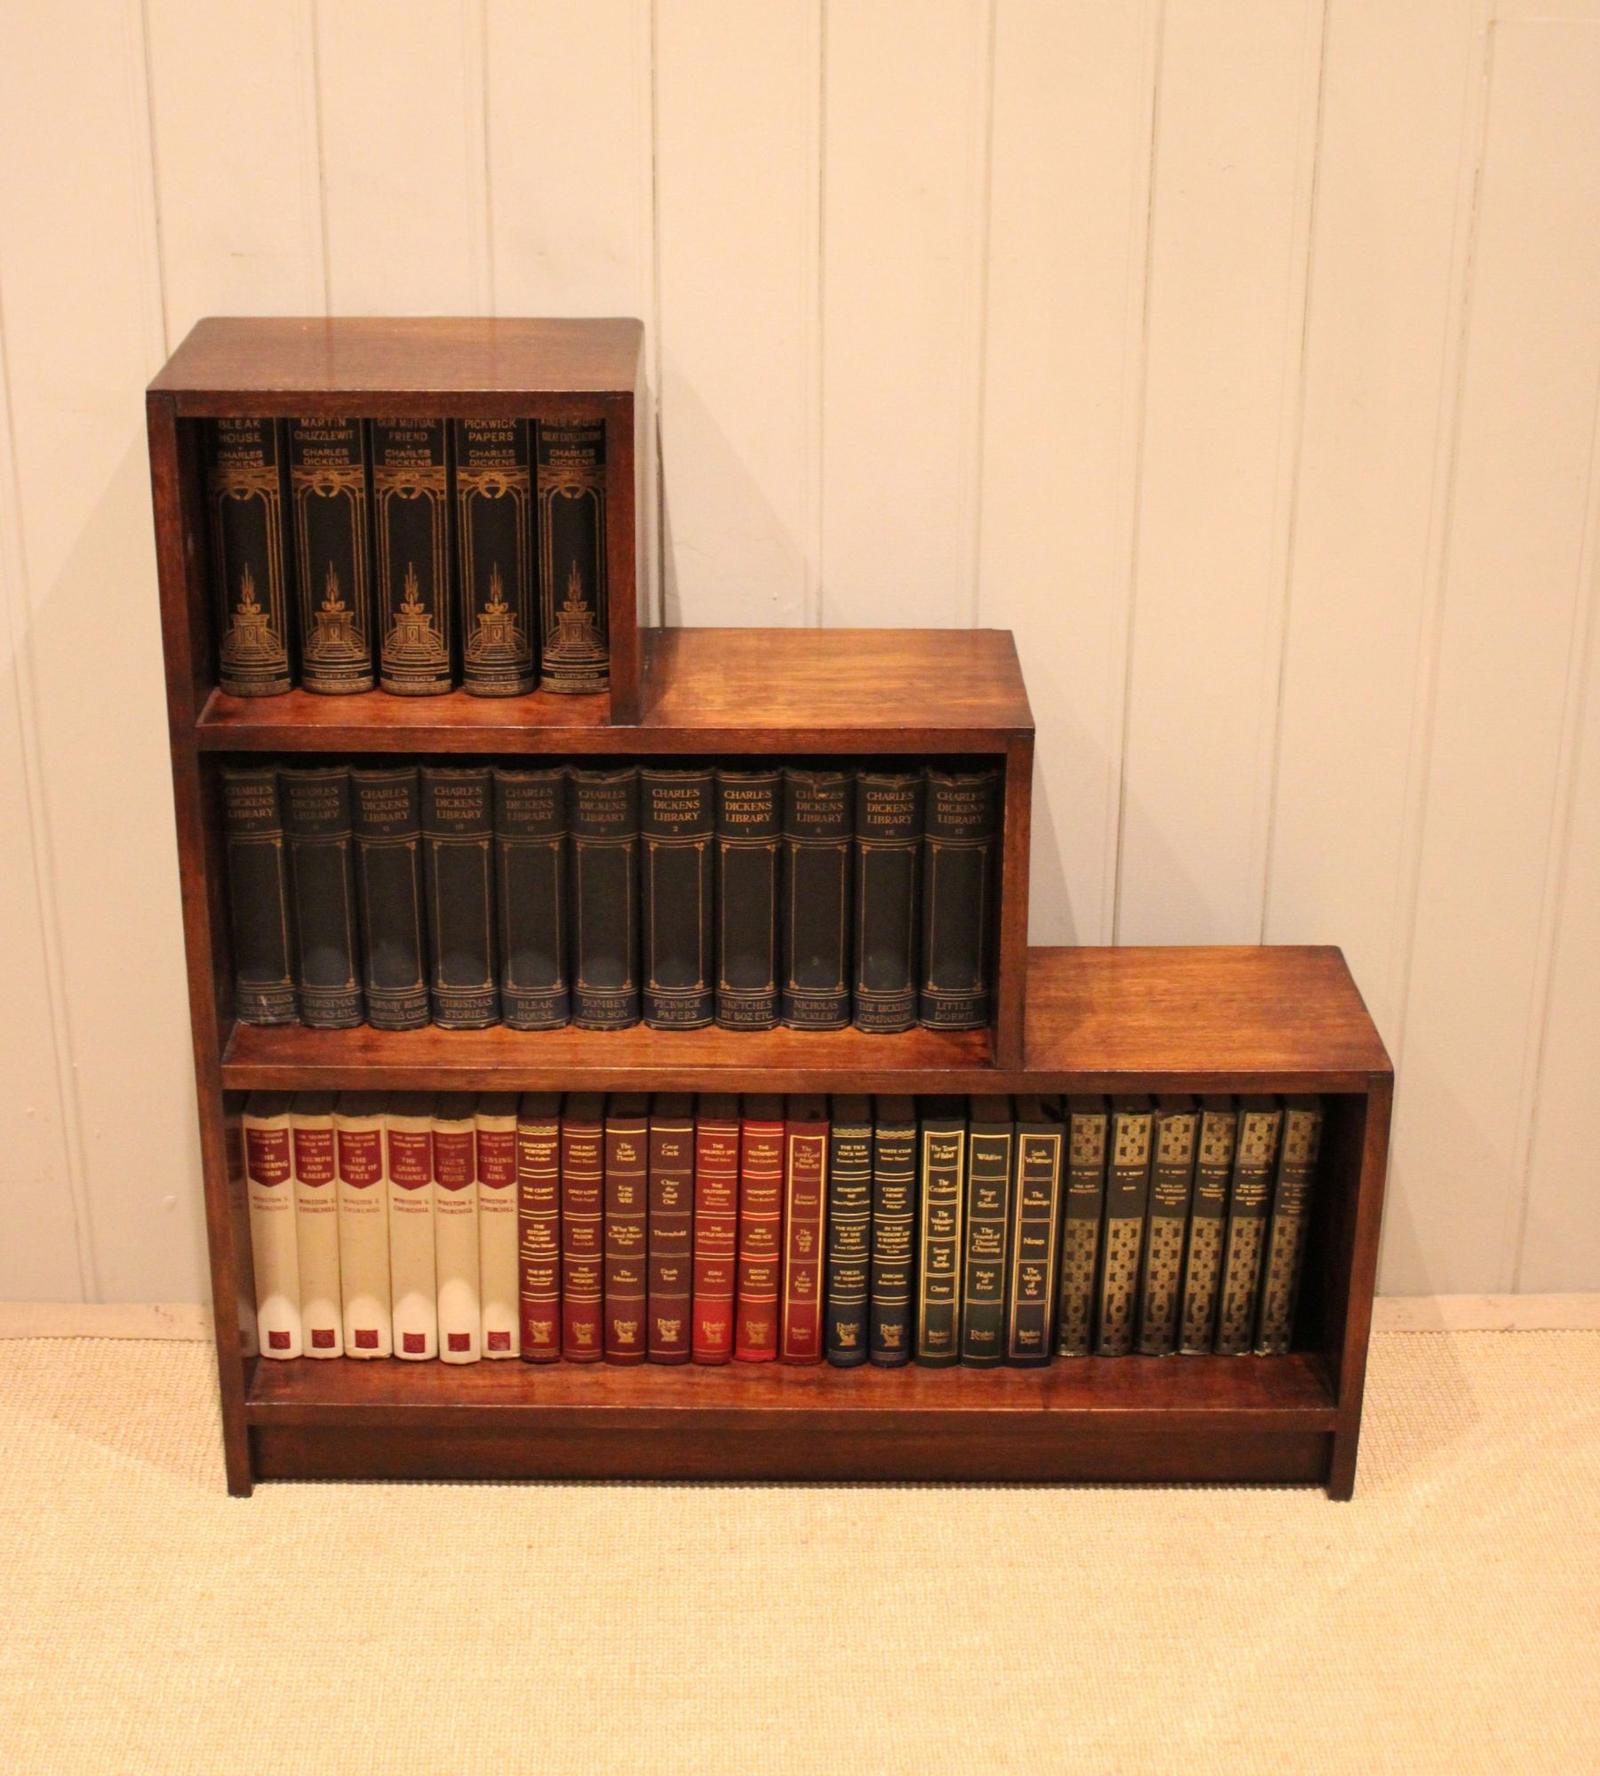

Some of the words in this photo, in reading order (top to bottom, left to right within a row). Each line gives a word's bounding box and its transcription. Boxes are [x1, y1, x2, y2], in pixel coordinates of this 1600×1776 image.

[465, 418, 518, 429] PICKWICK
[389, 431, 428, 441] FRIEND
[468, 431, 515, 441] PAPERS
[217, 450, 264, 459] CHARLES
[303, 448, 349, 457] CHARLES
[385, 449, 432, 458] CHARLES
[469, 449, 516, 458] CHARLES
[549, 449, 596, 458] CHARLES
[217, 459, 264, 467] DICKENS
[303, 457, 350, 466] DICKENS
[385, 458, 432, 467] DICKENS
[469, 458, 517, 467] DICKENS
[549, 458, 597, 467] DICKENS
[360, 787, 409, 799] CHARLES
[433, 786, 483, 797] CHARLES
[505, 788, 554, 799] CHARLES
[578, 789, 627, 800] CHARLES
[652, 788, 701, 799] CHARLES
[723, 790, 773, 800] CHARLES
[866, 791, 915, 801] CHARLES
[936, 791, 985, 801] CHARLES
[362, 799, 410, 810] DICKENS
[435, 798, 484, 808] DICKENS
[506, 799, 555, 810] DICKENS
[579, 800, 628, 811] DICKENS
[653, 800, 701, 811] DICKENS
[725, 801, 774, 812] DICKENS
[796, 801, 845, 812] DICKENS
[866, 802, 915, 814] DICKENS
[936, 802, 985, 814] DICKENS
[227, 808, 274, 819] LIBRARY
[363, 811, 409, 823] LIBRARY
[436, 809, 483, 820] LIBRARY
[507, 811, 555, 822] LIBRARY
[579, 812, 626, 823] LIBRARY
[654, 811, 700, 823] LIBRARY
[725, 812, 773, 823] LIBRARY
[797, 812, 844, 824] LIBRARY
[867, 814, 913, 825] LIBRARY
[937, 814, 982, 825] LIBRARY
[440, 998, 493, 1009] CHRISTMAS
[517, 1000, 554, 1009] BLEAK
[582, 999, 628, 1008] DOMBEY
[653, 999, 701, 1009] PICKWICK
[721, 1000, 773, 1009] SKETCHES
[793, 1000, 839, 1010] NICHOLAS
[936, 1000, 974, 1010] LITTLE
[445, 1009, 489, 1018] STORIES
[517, 1010, 555, 1019] HOUSE
[607, 1009, 629, 1017] SON
[657, 1010, 698, 1019] PAPERS
[793, 1010, 840, 1020] NICKLEBY
